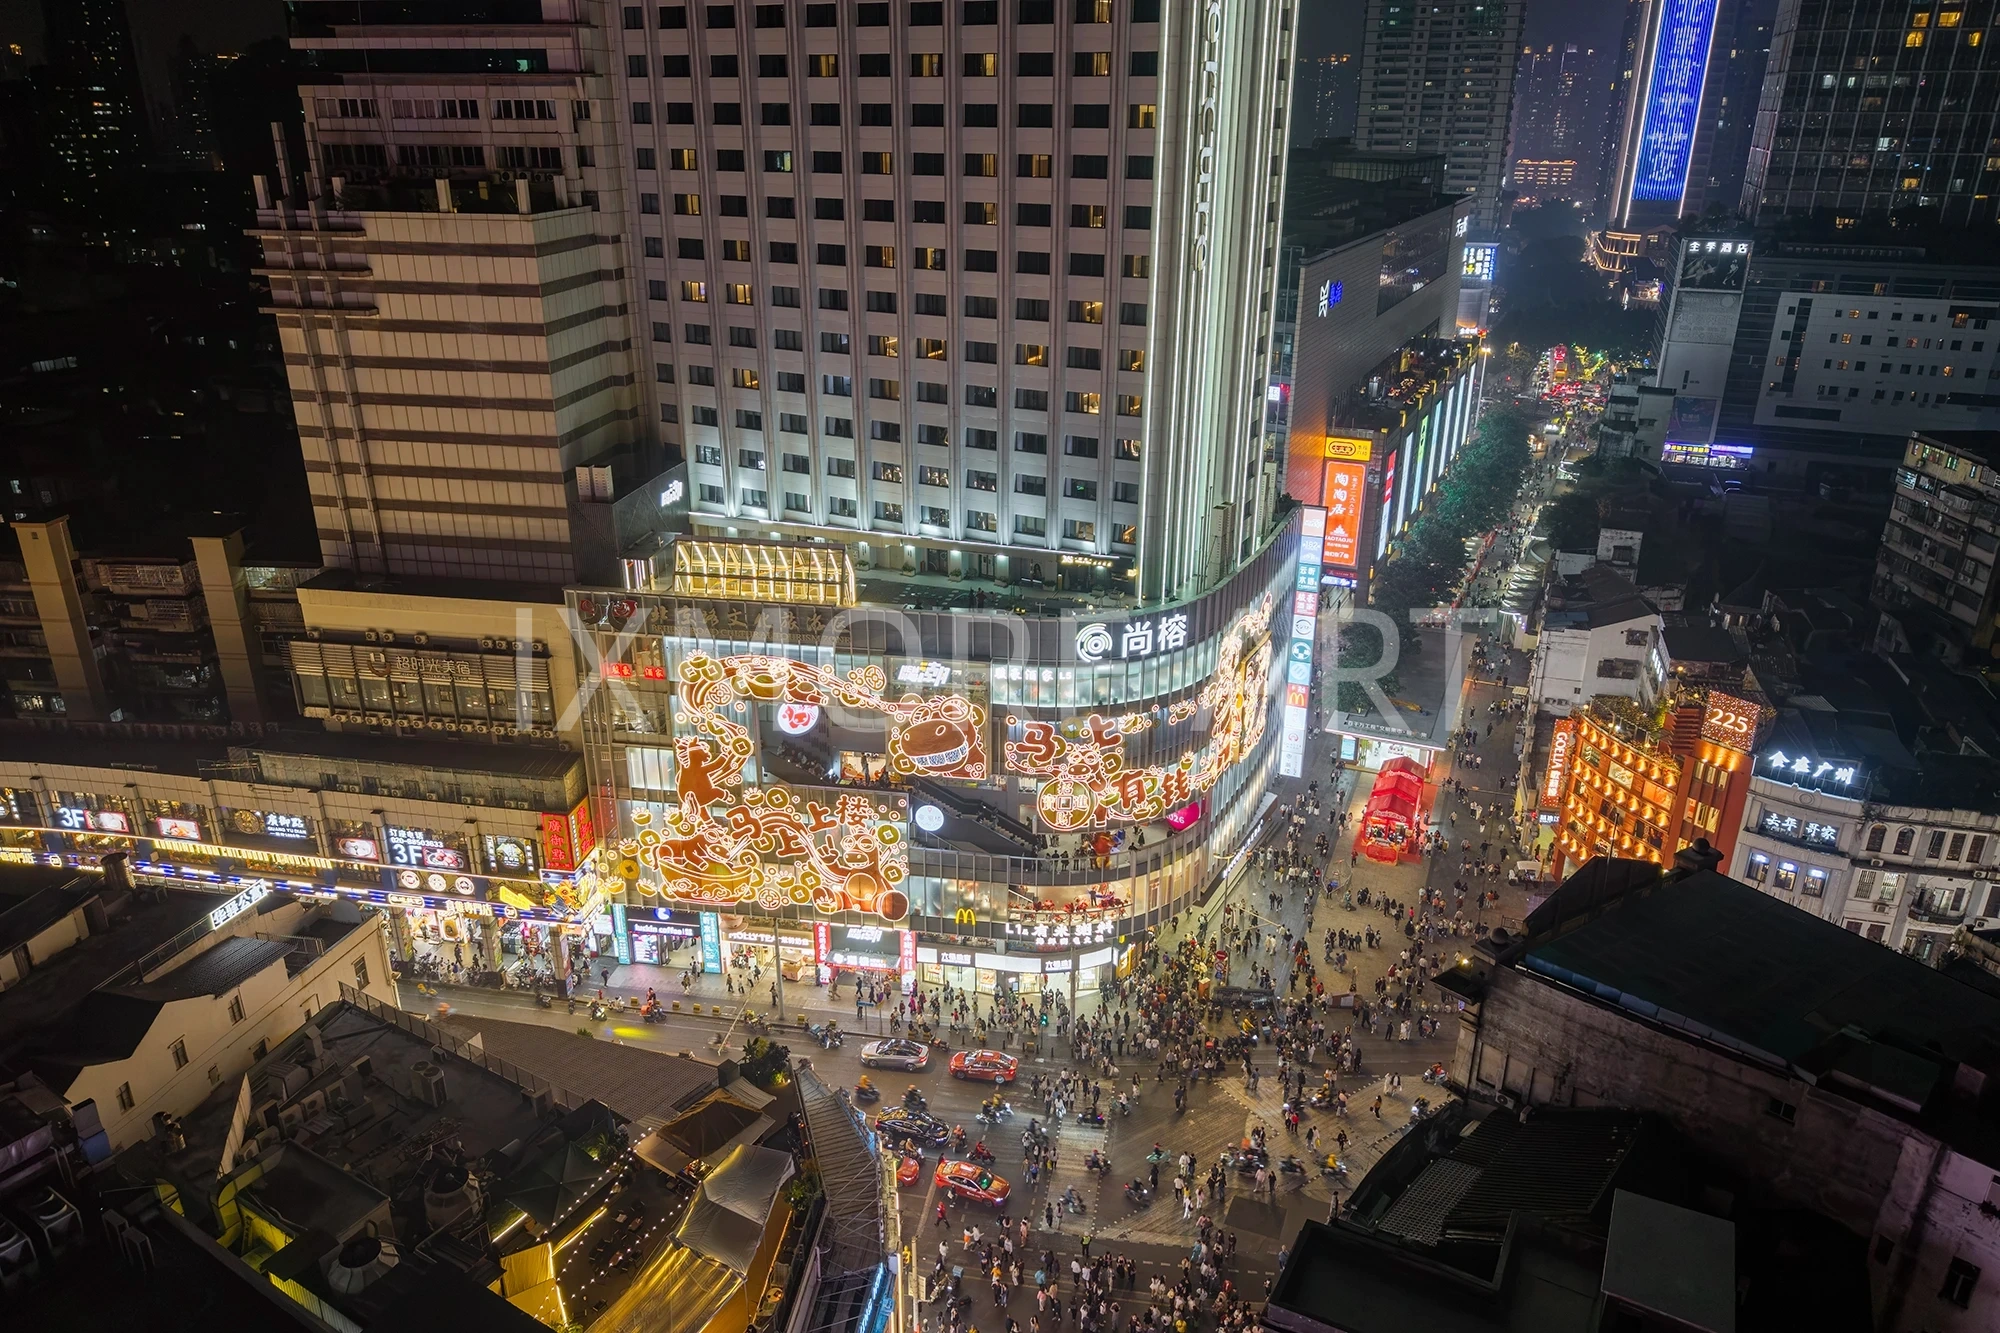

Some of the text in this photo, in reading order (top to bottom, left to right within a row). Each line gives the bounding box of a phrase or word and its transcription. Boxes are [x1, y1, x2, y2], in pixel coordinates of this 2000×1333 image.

[1689, 241, 1749, 254] 全季酒店
[1332, 472, 1349, 516] 陶陶居
[774, 632, 821, 642] TOURISM
[1121, 613, 1187, 658] 尚榕
[395, 655, 471, 675] 超时光美宿
[1710, 708, 1749, 733] 225
[1551, 731, 1568, 769] GOELIA
[60, 807, 83, 828] 3F
[1166, 811, 1185, 825] 026
[392, 844, 423, 864] 3F
[634, 923, 682, 936] luckin coffee
[728, 932, 758, 941] MOLLY
